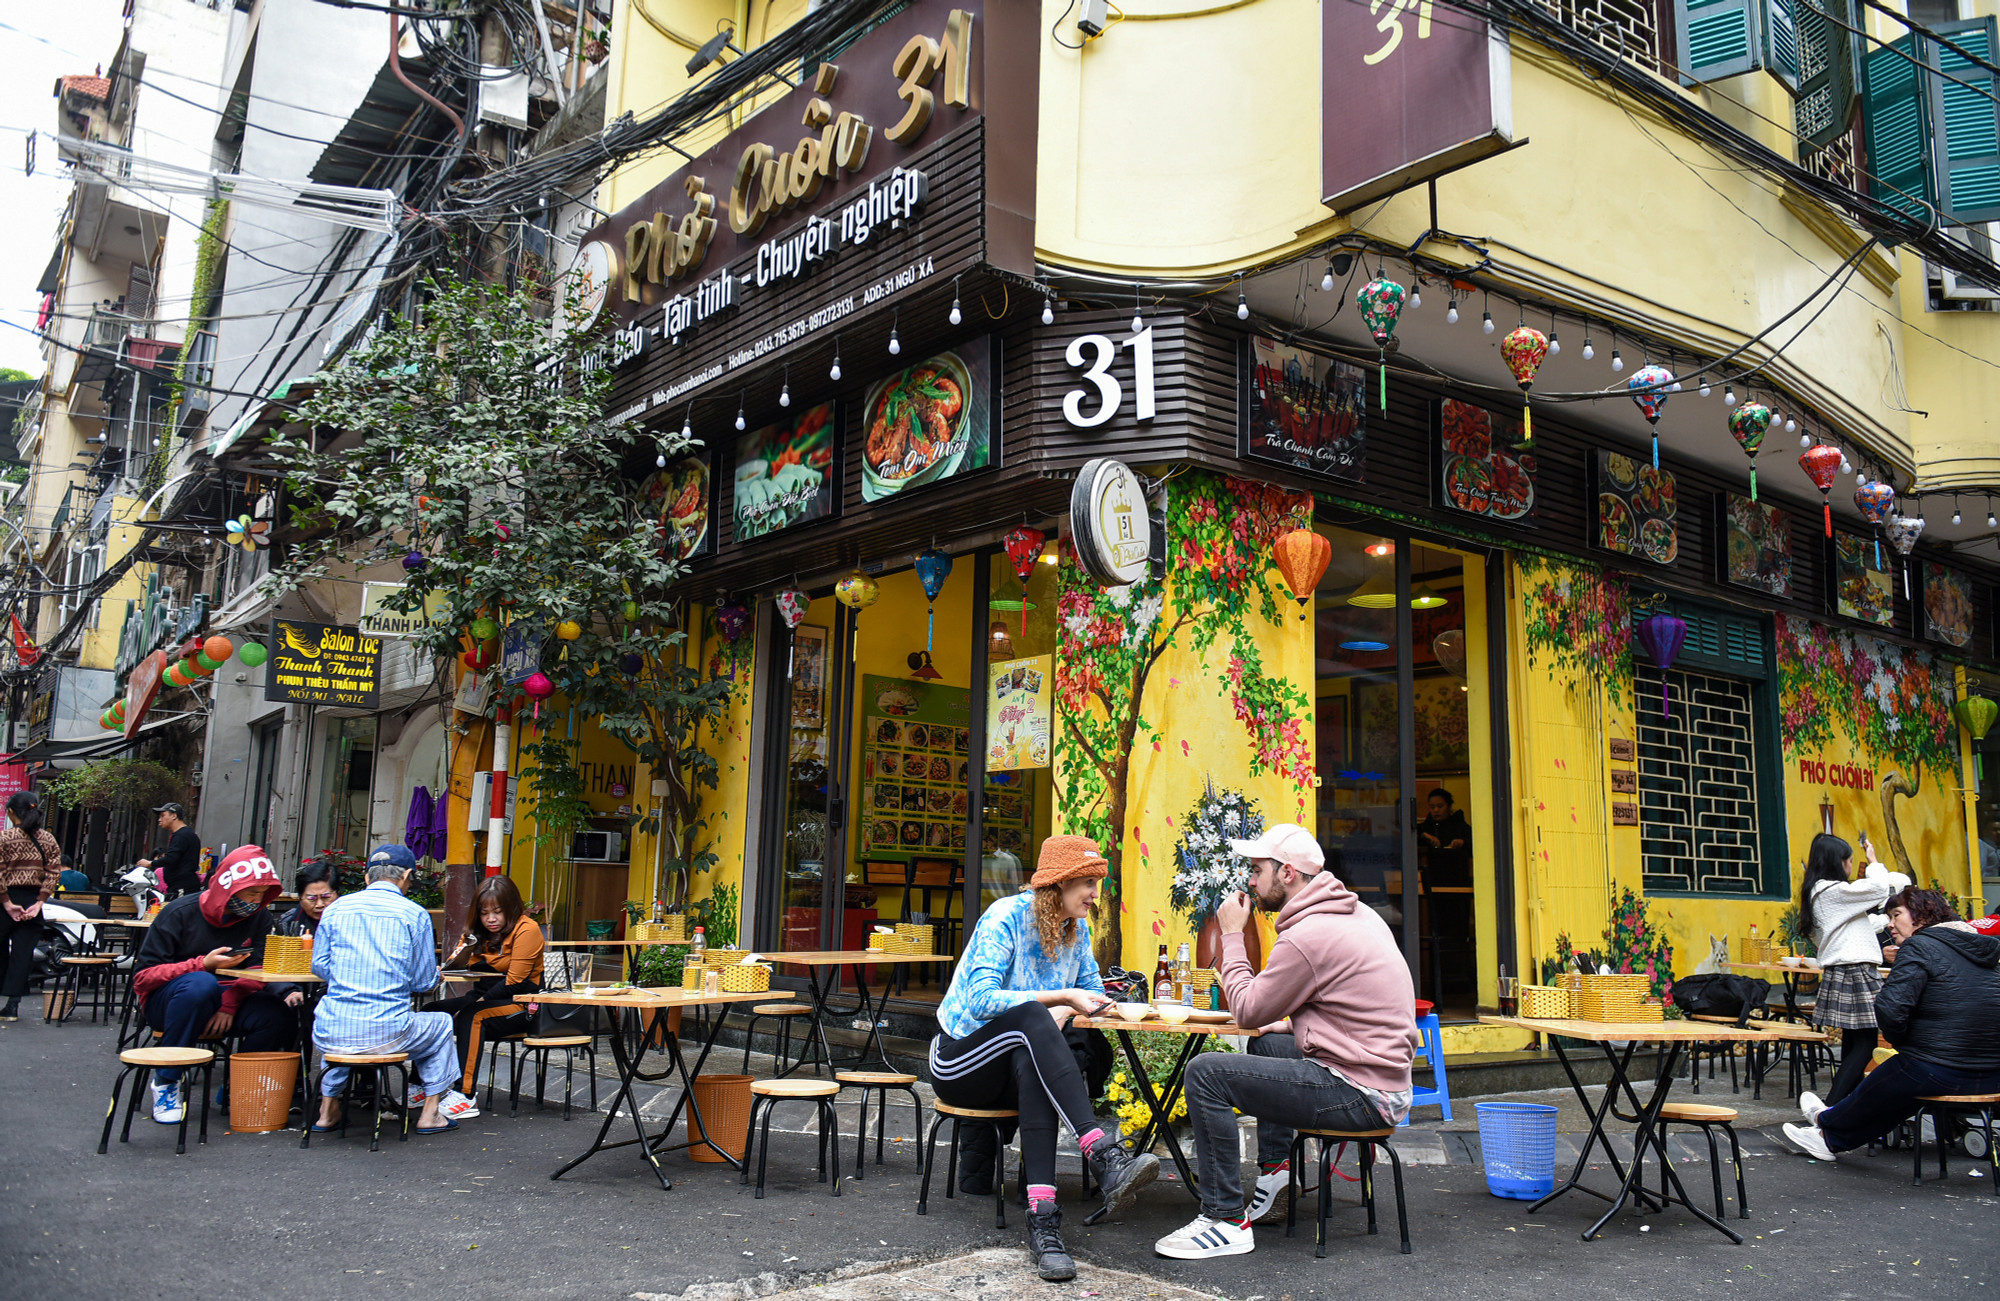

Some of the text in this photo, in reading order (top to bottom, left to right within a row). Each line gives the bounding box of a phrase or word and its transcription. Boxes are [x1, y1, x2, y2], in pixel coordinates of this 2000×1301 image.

[622, 9, 975, 304] Phở Cuốn 31
[662, 293, 692, 346] Tận
[696, 267, 733, 320] tình
[756, 215, 831, 288] Chuyên
[841, 166, 919, 245] nghiệp
[884, 278, 895, 296] 31
[895, 265, 916, 290] NGŨ
[918, 256, 935, 280] XÃ
[1062, 326, 1156, 428] 31
[1264, 433, 1282, 448] Trà
[1283, 439, 1314, 457] Chanh
[1315, 447, 1337, 463] Cam
[319, 627, 355, 653] Salon
[274, 656, 375, 678] Thanh Thanh
[276, 675, 304, 687] PHUN
[305, 676, 330, 689] THÊU
[359, 679, 374, 692] MỸ
[287, 688, 310, 700] NỐI
[311, 691, 328, 701] MI
[336, 693, 364, 704] NAIL
[1027, 697, 1036, 714] 2
[580, 762, 636, 796] THAN
[1799, 753, 1827, 785] PHỞ
[1862, 768, 1874, 792] 31
